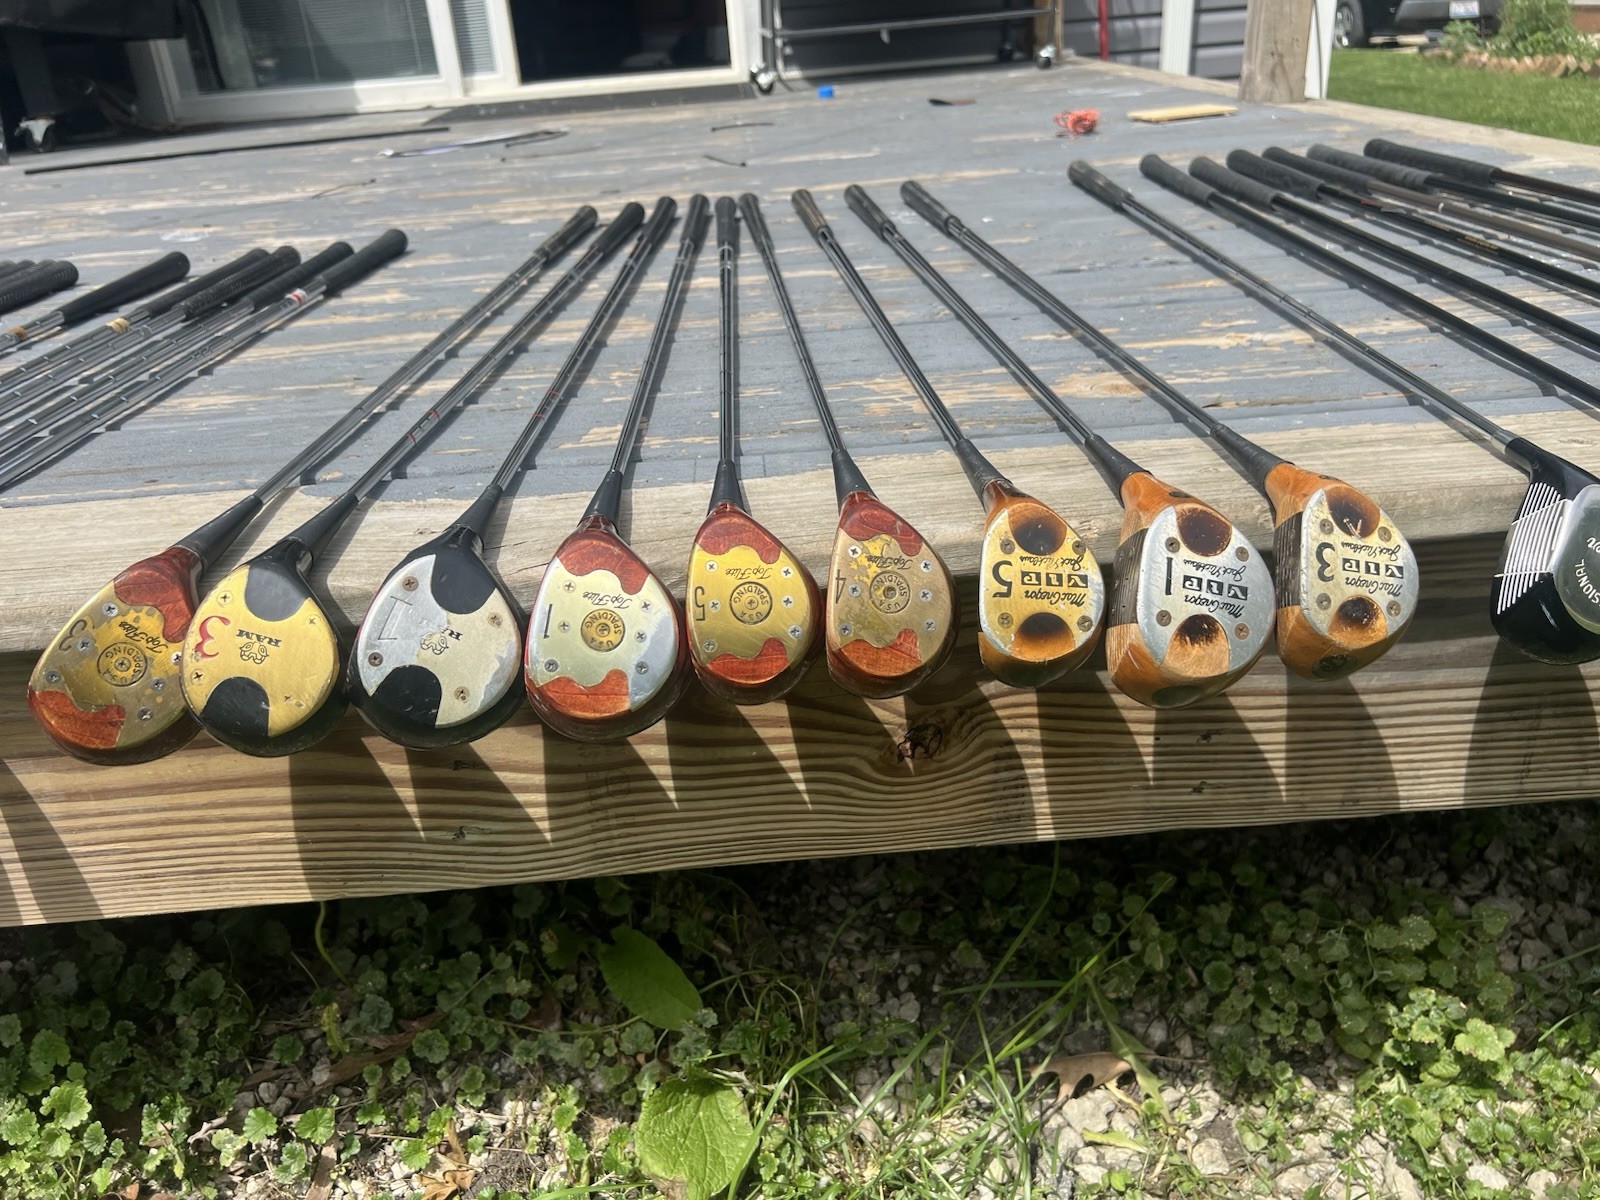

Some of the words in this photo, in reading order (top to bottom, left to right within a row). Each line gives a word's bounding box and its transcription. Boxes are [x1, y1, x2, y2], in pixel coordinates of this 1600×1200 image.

[1340, 540, 1378, 559] Nicklaus
[1378, 543, 1402, 562] Jack
[725, 565, 773, 580] Top-Flite
[1060, 554, 1085, 572] Jack
[1182, 558, 1222, 578] Nicklaus
[1222, 564, 1247, 582] Jack
[1315, 541, 1336, 583] 3
[1341, 557, 1404, 580] VIP
[835, 568, 847, 605] 4
[872, 573, 909, 598] SPALDING
[992, 559, 1013, 598] 5
[1021, 570, 1089, 588] VIP
[1164, 556, 1174, 596] 1
[1182, 574, 1249, 601] VIP
[1344, 575, 1404, 598] MacGregor
[1574, 558, 1600, 608] SIONAL
[694, 585, 706, 622] 5
[732, 584, 770, 606] SPALDING
[879, 599, 901, 611] USA
[1024, 587, 1087, 608] MacGregor
[1184, 593, 1246, 619] MacGregor
[378, 594, 414, 641] 1
[543, 603, 552, 639] 1
[584, 610, 623, 635] SPALDING
[739, 610, 763, 622] USA
[58, 618, 88, 653] 3
[191, 614, 232, 660] 3
[236, 628, 283, 648] RAM
[590, 636, 615, 649] USA
[104, 645, 142, 675] SPALDING
